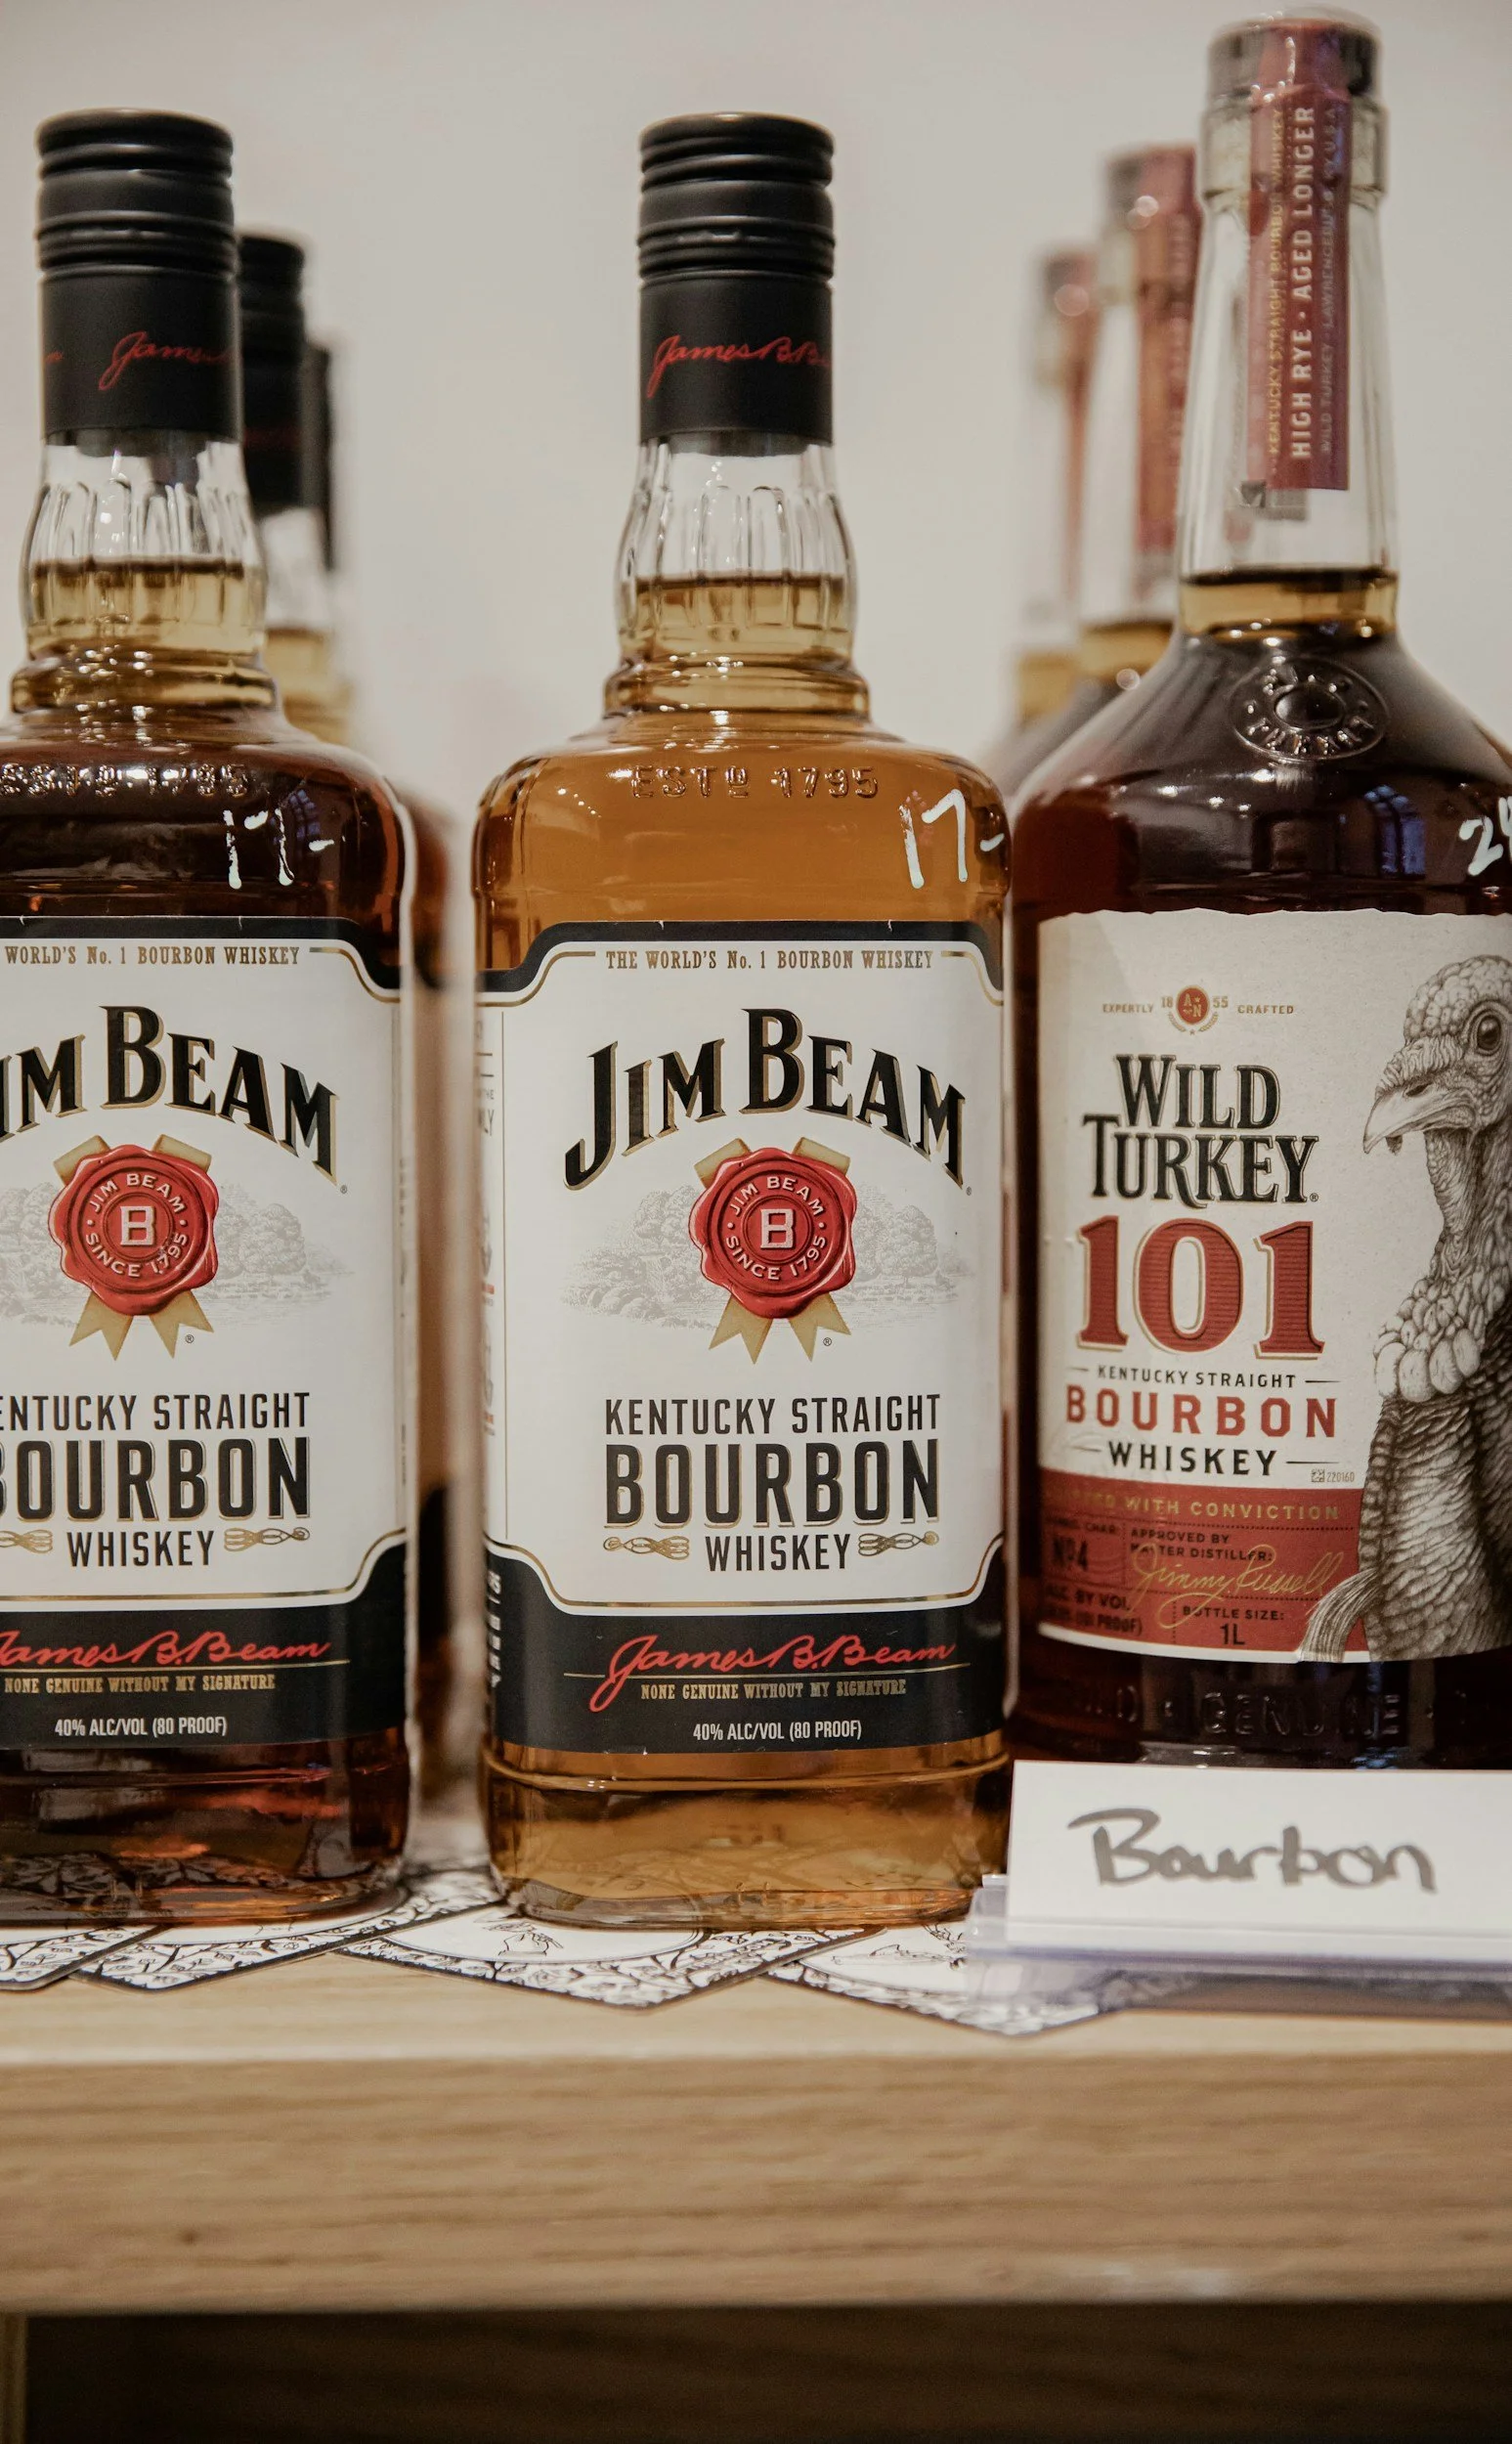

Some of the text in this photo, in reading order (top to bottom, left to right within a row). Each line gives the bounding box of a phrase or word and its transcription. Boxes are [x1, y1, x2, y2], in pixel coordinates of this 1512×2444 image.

[1292, 108, 1315, 458] HIGH RYE AGED LONGER
[771, 765, 879, 799] 1795
[5, 945, 300, 965] WORLD'S No. 1 BOURBON WHISKEY
[605, 949, 934, 970] THE WORLD'S No. 1 BOURBON WHISKEY
[1102, 1003, 1154, 1014] EXPERTLY
[1237, 1004, 1295, 1015] CRAFTED
[99, 1005, 340, 1187] BEAM
[563, 1007, 966, 1191] JIM BEAM
[1114, 1054, 1281, 1129] WILD
[1082, 1113, 1319, 1209] TURKEY
[90, 1173, 187, 1214] JIM BEAM
[729, 1176, 825, 1216] JIM BEAM
[120, 1205, 154, 1246] B
[760, 1208, 795, 1249] B
[85, 1232, 189, 1278] SINCE 1795
[725, 1235, 827, 1281] SINCE 1795
[1076, 1215, 1325, 1360] 101
[1097, 1365, 1297, 1388] KENTUCKY STRAIGHT
[153, 1392, 311, 1430] STRAIGHT
[604, 1393, 941, 1436] KENTUCKY STRAIGHT
[1066, 1383, 1337, 1439] BOURBON
[1108, 1440, 1278, 1476] WHISKEY
[603, 1438, 941, 1529] BOURBON
[1126, 1497, 1181, 1514] WITH
[1190, 1502, 1340, 1520] CONVICTION
[66, 1530, 214, 1568] WHISKEY
[705, 1533, 852, 1572] WHISKEY
[1130, 1528, 1231, 1545] APPROVED BY
[1182, 1605, 1284, 1622] BOTTLE SIZE:
[181, 1631, 330, 1662] Beam
[1220, 1623, 1246, 1645] 1L
[4, 1674, 276, 1694] NONE GENUINE WITHOUT MY SIGNATURE
[588, 1635, 771, 1713] James
[817, 1635, 957, 1667] Beam
[640, 1679, 907, 1700] NONE GENUINE WITHOUT MY SIGNATURE
[55, 1716, 228, 1738] 40% ALC/VOL (80 PROOF)
[692, 1720, 863, 1742] 40% ALC/VOL (80 PROOF)
[1066, 1807, 1438, 1893] Bourbon
